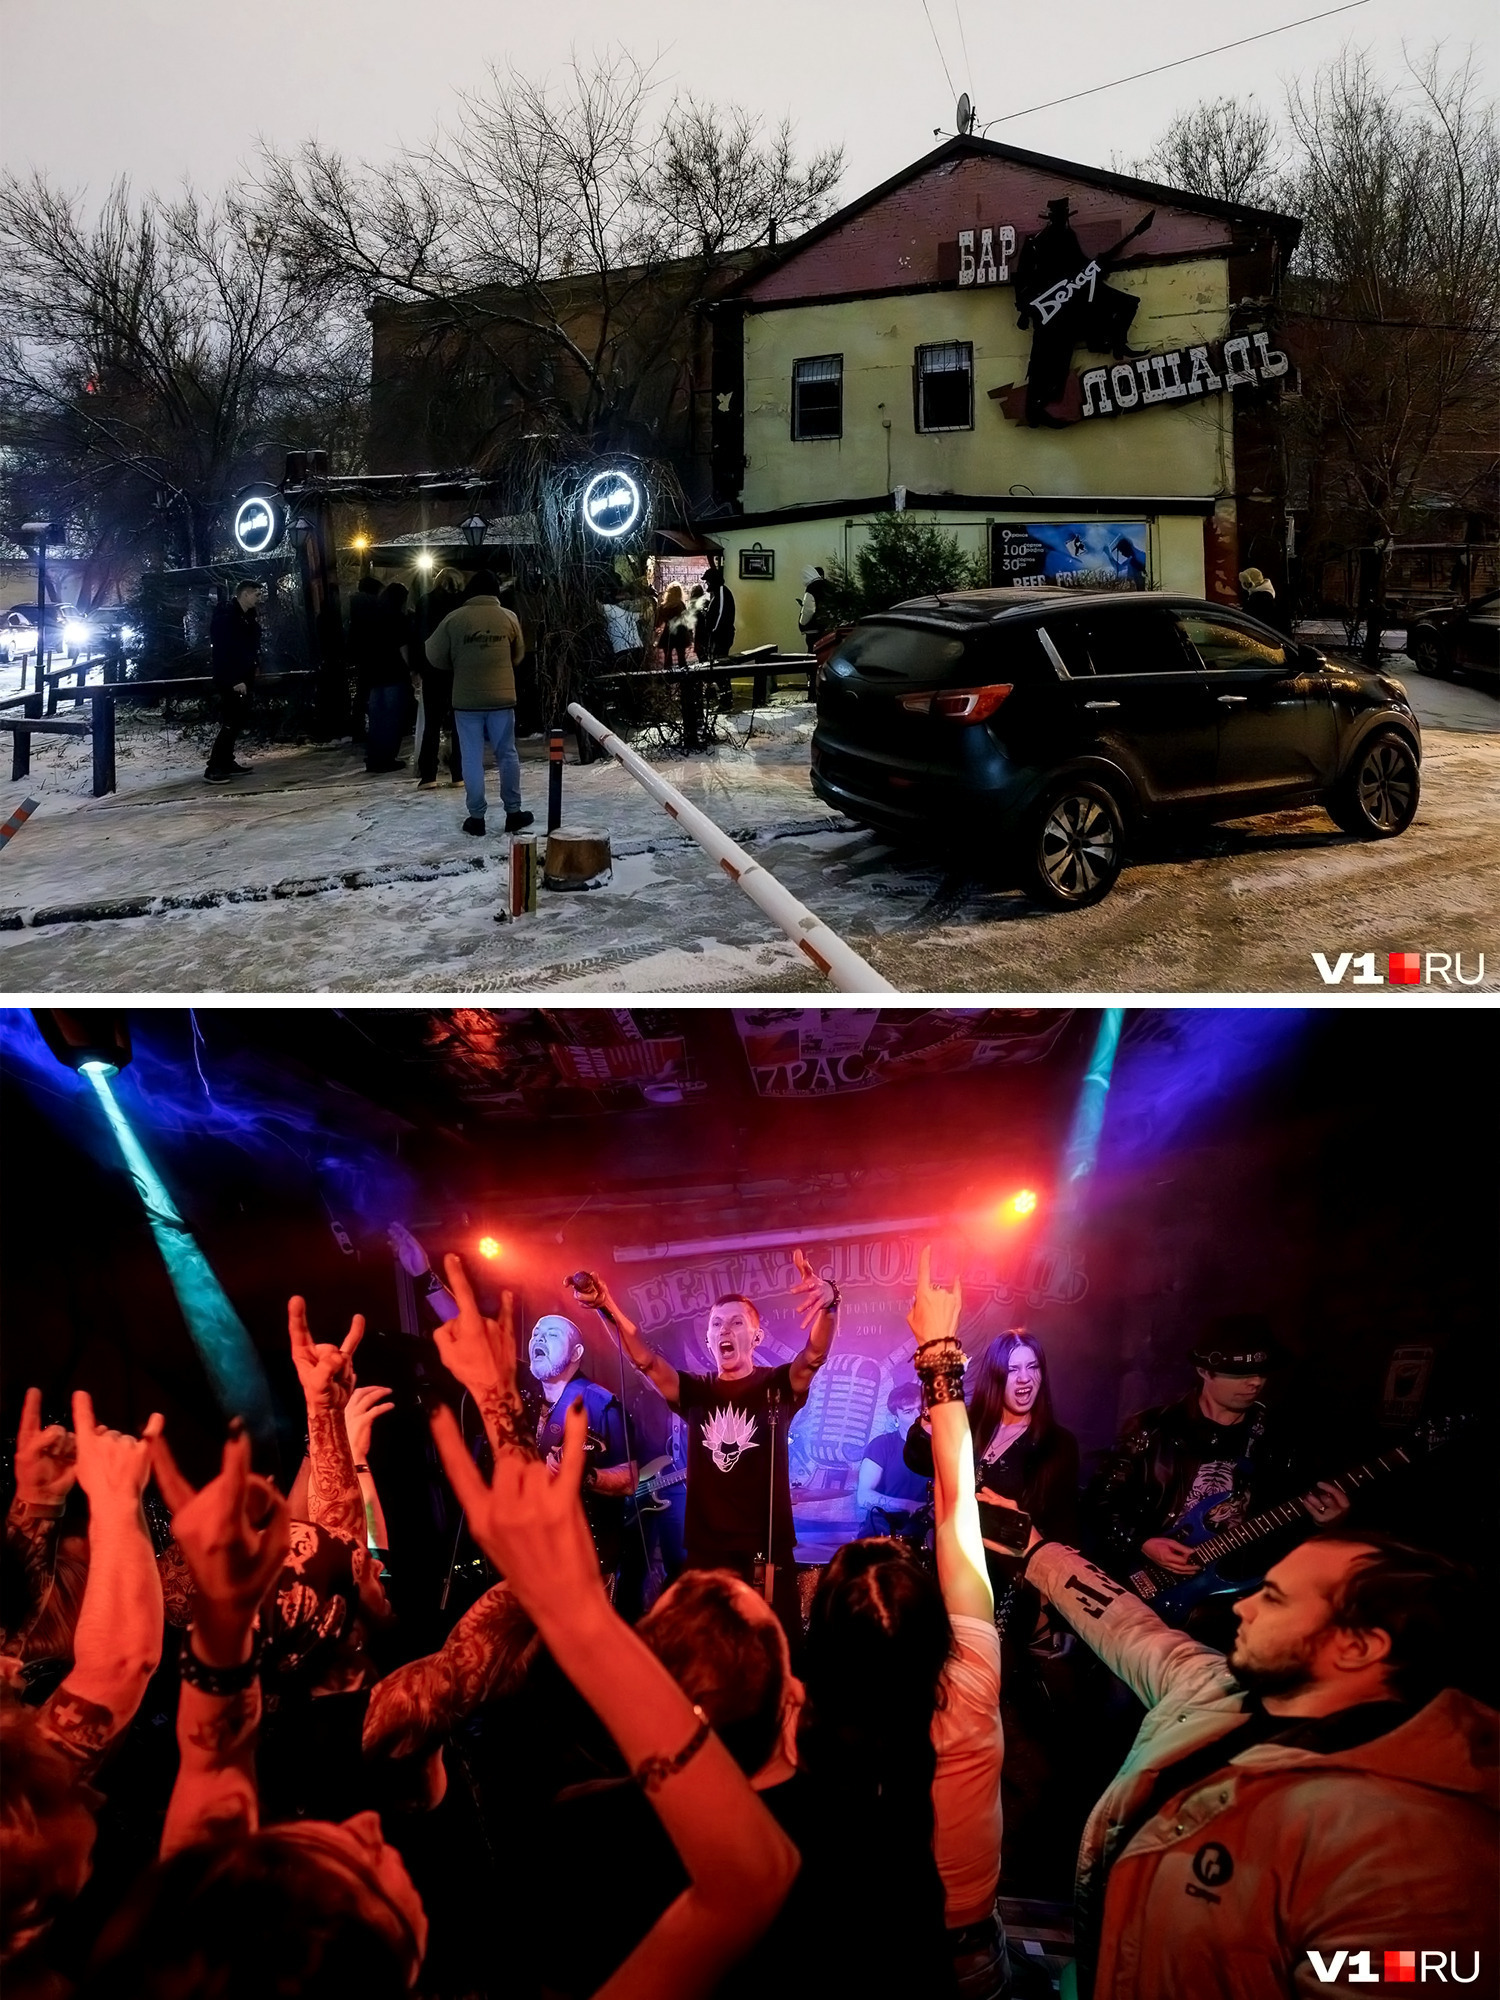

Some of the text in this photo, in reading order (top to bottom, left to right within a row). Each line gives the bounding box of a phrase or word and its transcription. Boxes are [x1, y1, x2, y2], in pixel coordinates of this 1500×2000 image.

[958, 225, 1016, 285] БАР
[1030, 260, 1101, 325] Белая
[1082, 331, 1289, 417] ЛОШАДЬ
[1003, 545, 1026, 556] 100
[1003, 559, 1019, 571] 30
[855, 1324, 883, 1337] 2001
